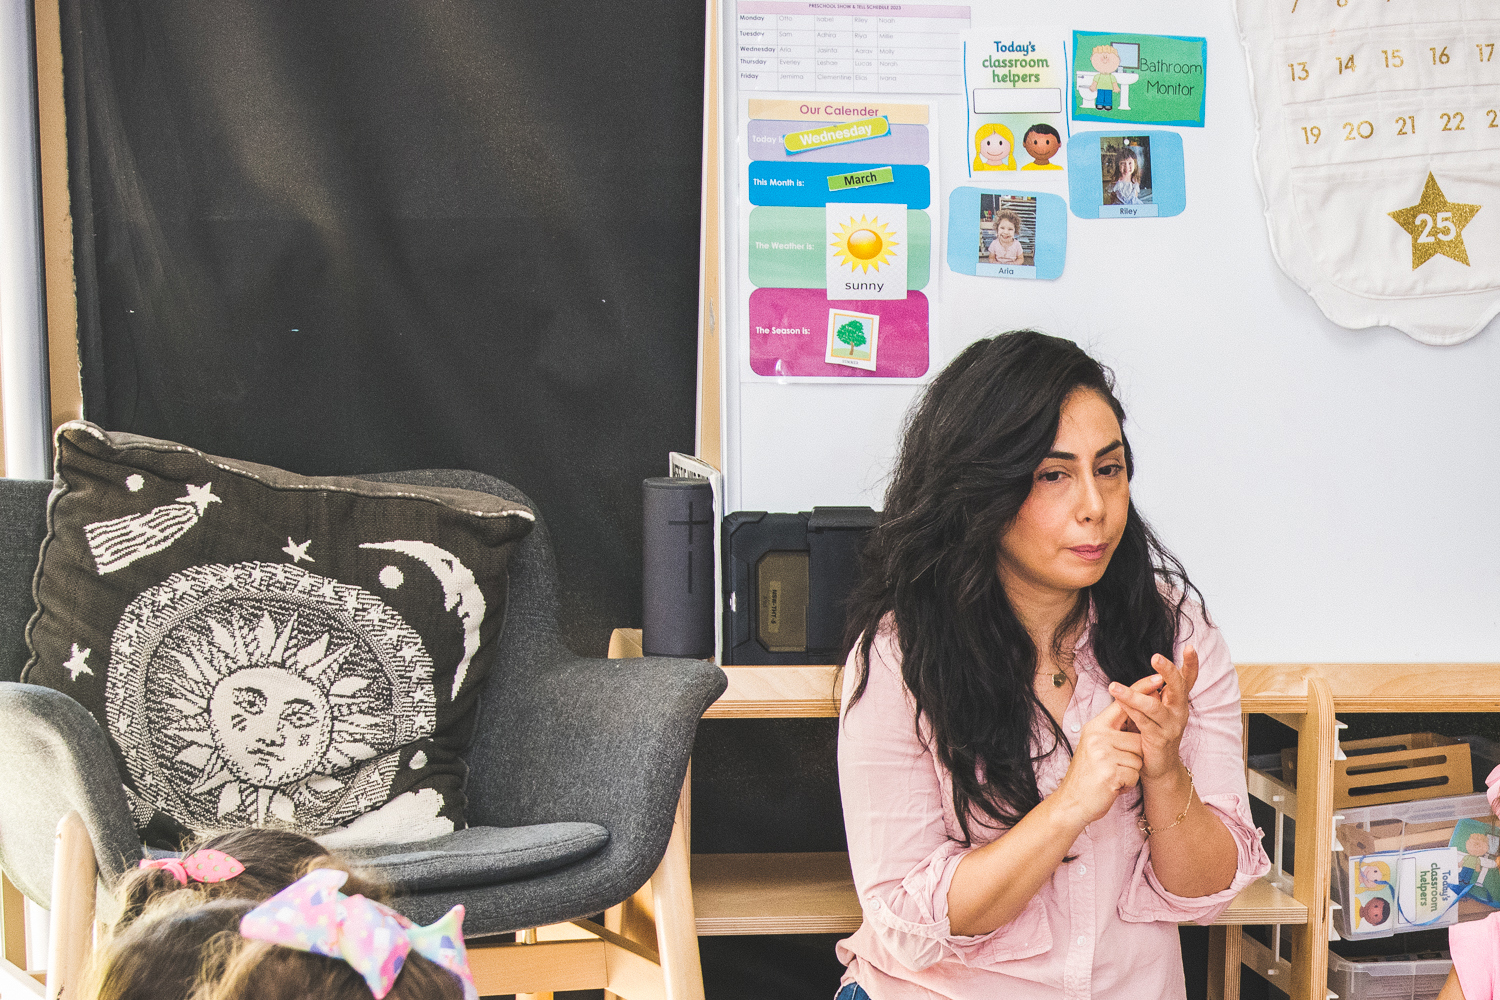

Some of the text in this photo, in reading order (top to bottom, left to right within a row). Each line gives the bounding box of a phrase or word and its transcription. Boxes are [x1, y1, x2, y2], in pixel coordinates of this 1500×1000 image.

[993, 41, 1036, 56] Today's
[740, 58, 767, 66] Thursday
[982, 54, 1050, 69] classroom
[1139, 57, 1203, 75] Bathroom
[1287, 61, 1310, 82] 13
[1335, 54, 1357, 75] 14
[1381, 48, 1404, 68] 15
[1429, 46, 1451, 66] 16
[1475, 43, 1496, 63] 17
[991, 69, 1041, 87] helpers
[1146, 81, 1194, 96] Monitor
[799, 104, 879, 117] Our Calender
[799, 123, 873, 147] Wednesday
[1301, 125, 1322, 145] 19
[1342, 120, 1375, 142] 20
[1395, 116, 1416, 136] 21
[1439, 112, 1466, 132] 22
[752, 134, 777, 145] Today
[753, 178, 805, 187] This Month is:
[844, 172, 877, 186] March
[1119, 207, 1138, 217] Riley
[1414, 212, 1457, 244] 25
[755, 241, 815, 251] The Weather is:
[998, 267, 1015, 276] Aria
[845, 282, 885, 293] sunny
[755, 326, 811, 336] The Season is:
[1416, 870, 1430, 907] helpers
[1430, 862, 1441, 913] classroom
[1439, 869, 1451, 902] Today's
